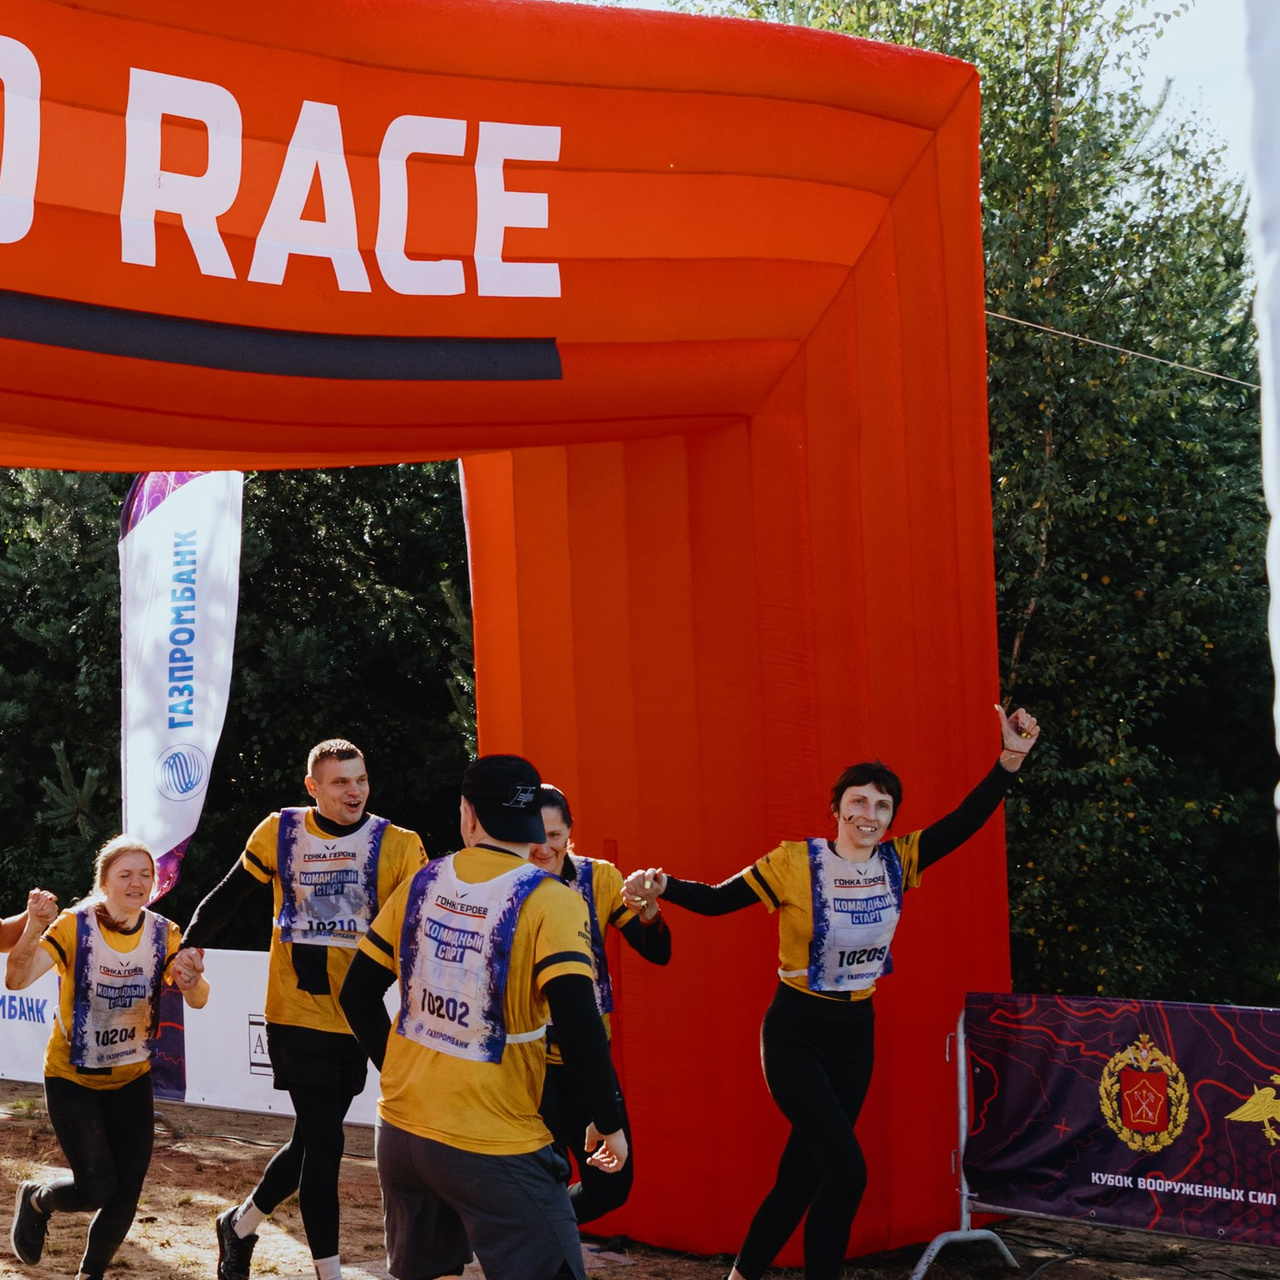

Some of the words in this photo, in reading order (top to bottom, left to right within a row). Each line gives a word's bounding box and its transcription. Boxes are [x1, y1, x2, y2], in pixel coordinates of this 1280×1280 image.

[120, 67, 562, 299] RACE
[168, 528, 198, 730] ГАЗПРОМБАНК
[329, 851, 356, 859] ГЕРОЕВ
[300, 869, 357, 885] КОМАНДНЫЙ
[834, 878, 861, 886] ГОНКА
[316, 884, 342, 896] СТАРТ
[834, 894, 893, 912] КОМАНДНЫЙ
[853, 911, 880, 924] СТАРТ
[99, 964, 122, 976] ГОНКА
[421, 988, 470, 1028] 10202
[95, 1026, 136, 1047] 10204
[426, 1028, 470, 1050] ГАЗПРОМБАНК
[106, 1048, 137, 1061] ГАЗПРОМБАНК
[1091, 1172, 1134, 1189] КУБОК
[1137, 1177, 1245, 1202] ВООРУЖЕННЫХ
[1248, 1190, 1277, 1206] СИЛ
